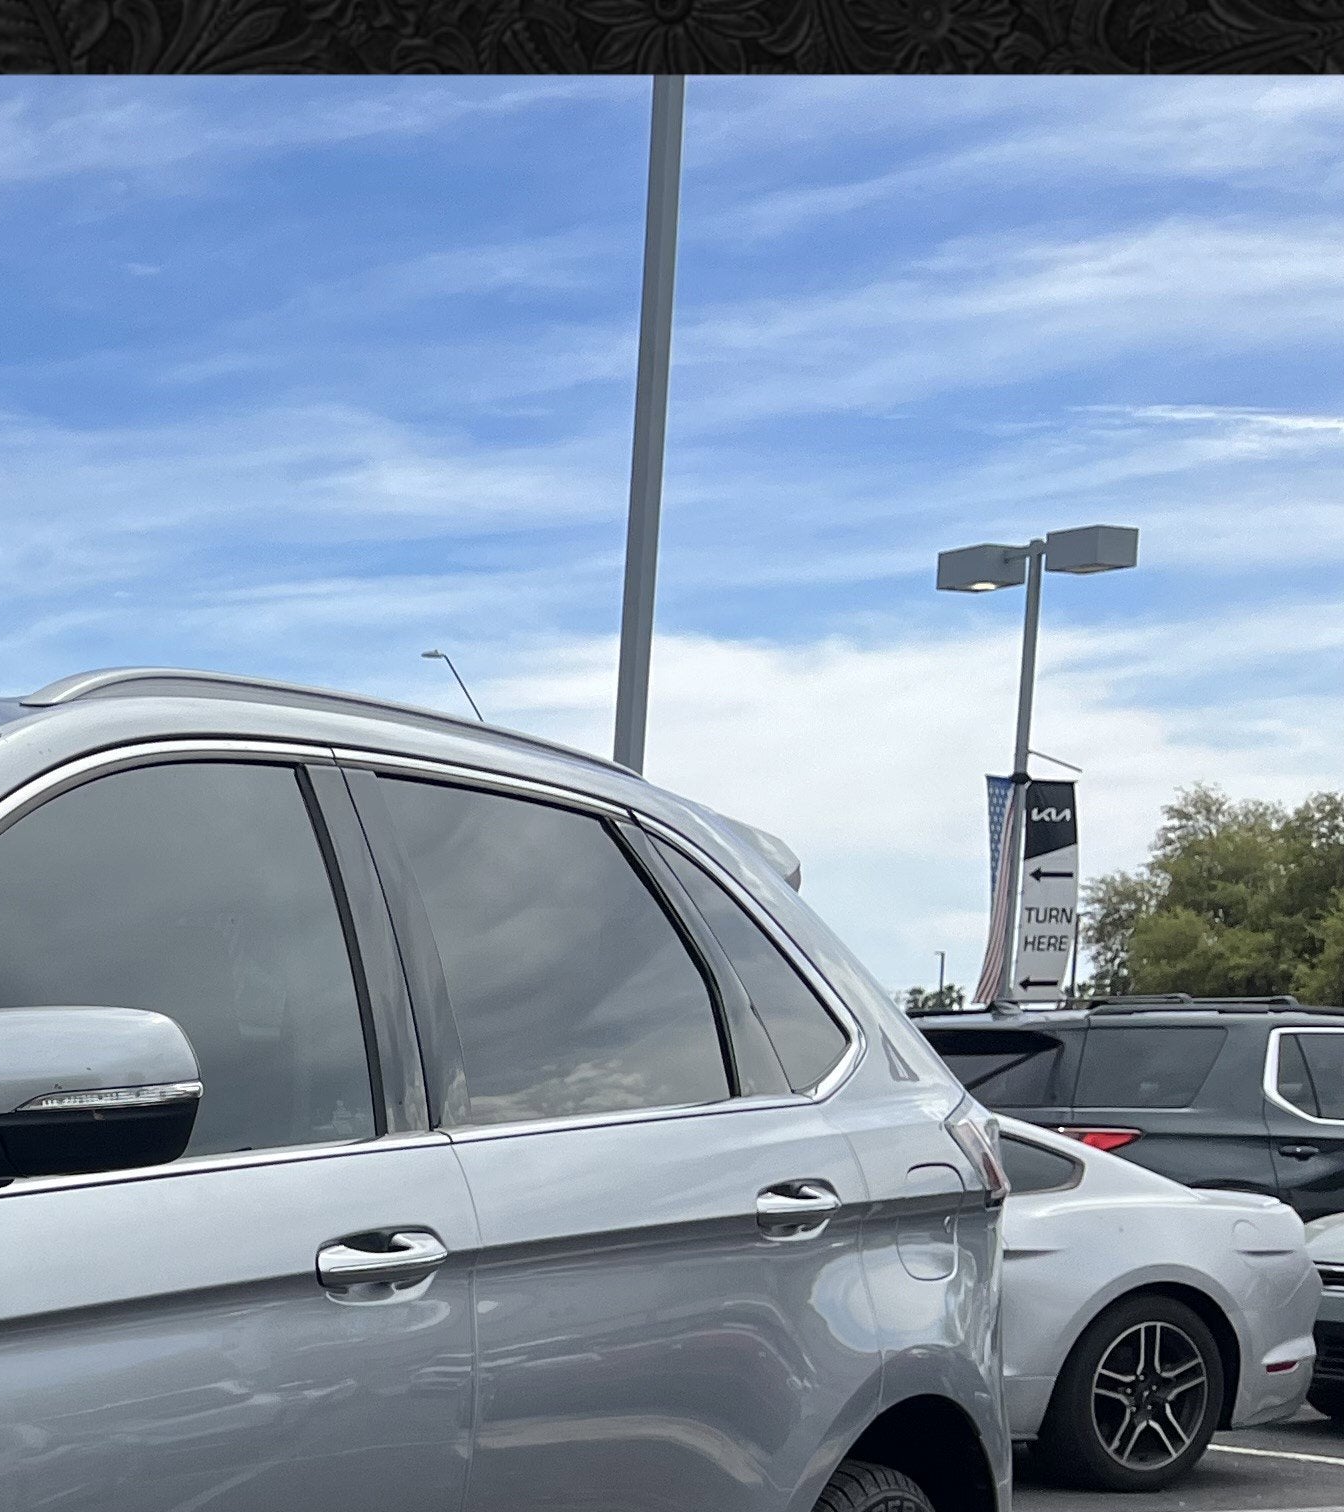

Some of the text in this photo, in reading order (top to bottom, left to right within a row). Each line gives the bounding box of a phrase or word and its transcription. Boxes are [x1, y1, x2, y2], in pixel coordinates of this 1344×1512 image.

[1031, 806, 1072, 822] KIA
[1025, 907, 1074, 924] TURN
[1024, 935, 1069, 952] HERE
